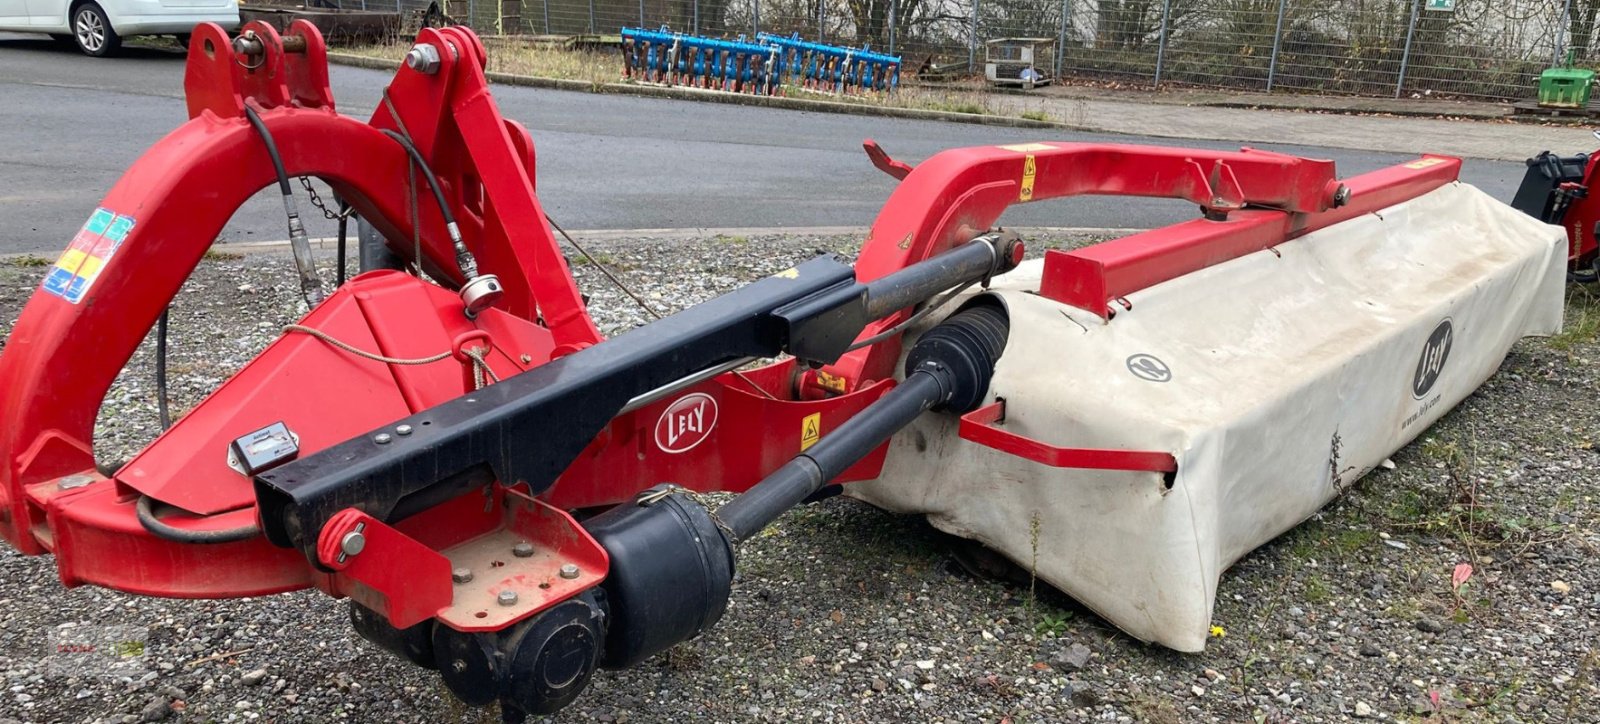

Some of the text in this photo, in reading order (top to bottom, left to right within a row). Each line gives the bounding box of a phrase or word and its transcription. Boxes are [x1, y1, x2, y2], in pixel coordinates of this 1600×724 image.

[1417, 327, 1451, 390] LELY
[668, 399, 706, 447] LELY
[1401, 394, 1441, 430] www.lely.com
